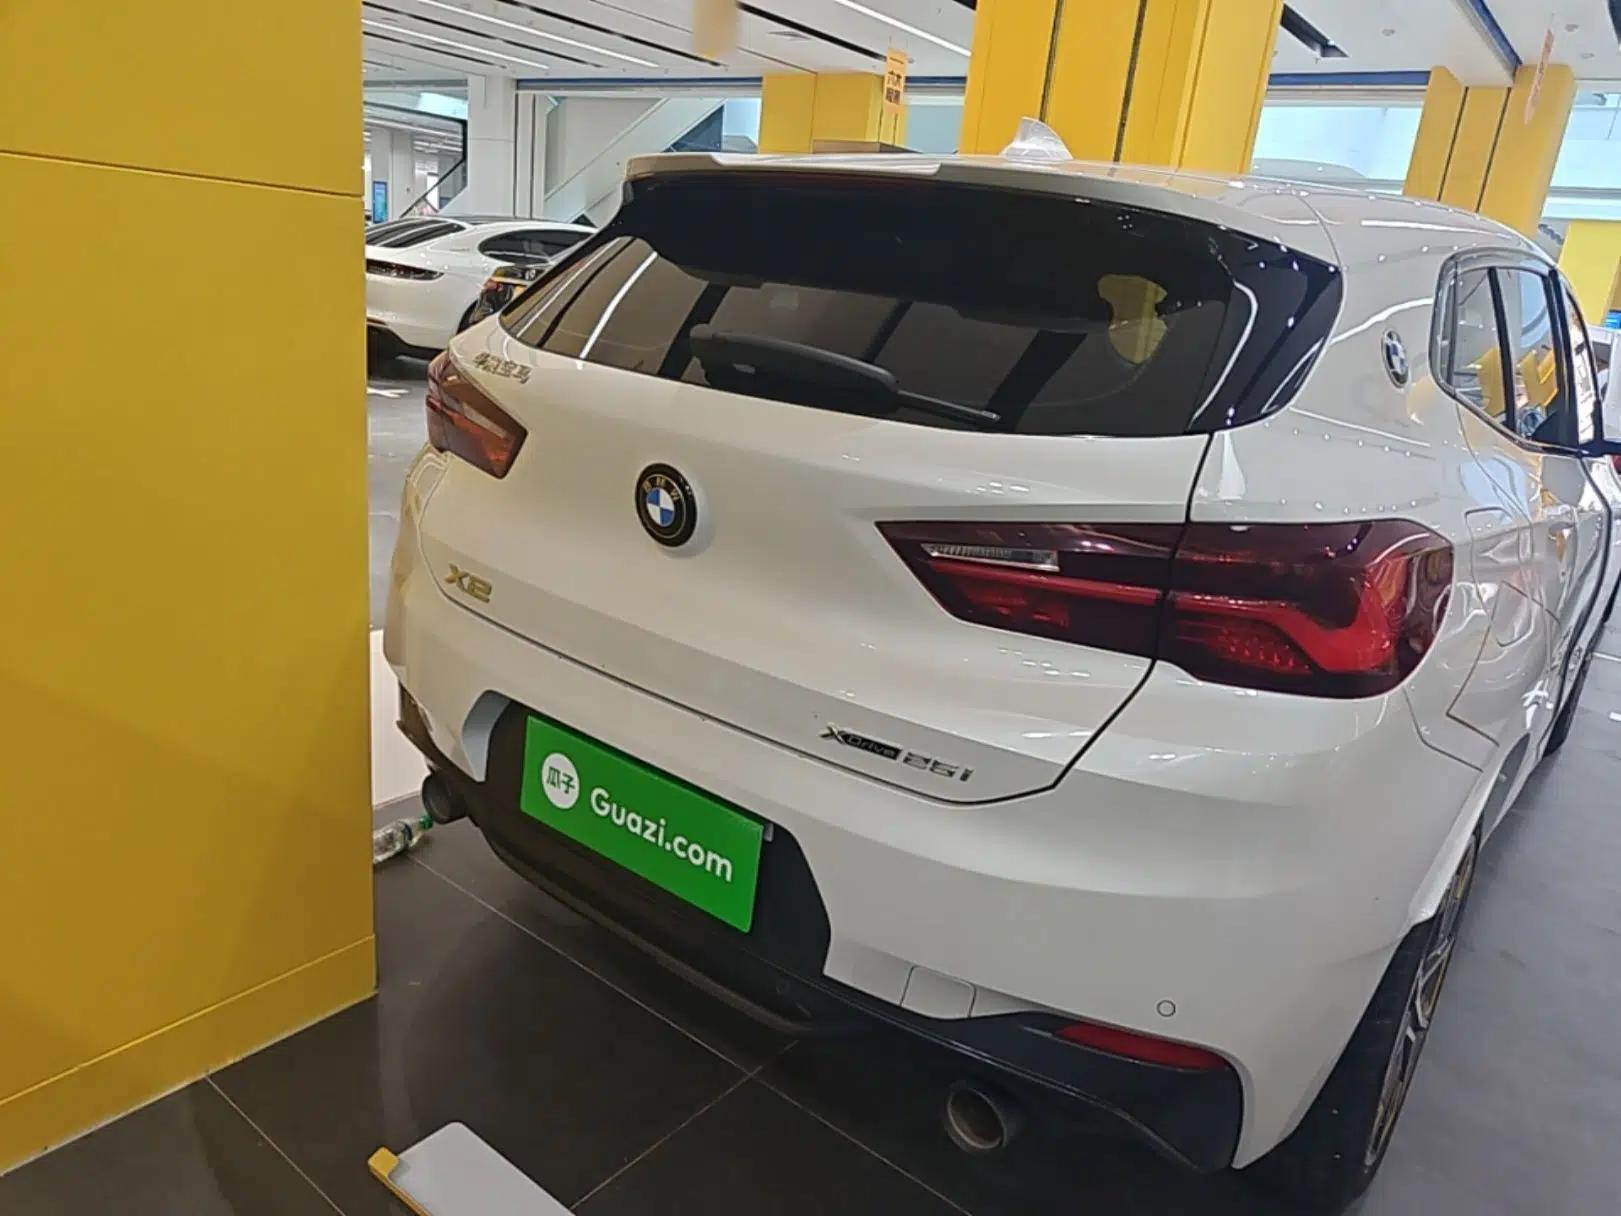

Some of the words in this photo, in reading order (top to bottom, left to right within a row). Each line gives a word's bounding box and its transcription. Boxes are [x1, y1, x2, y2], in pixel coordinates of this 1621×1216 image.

[444, 562, 493, 604] X2
[545, 765, 576, 795] 瓜子
[590, 787, 734, 883] Guazi.com
